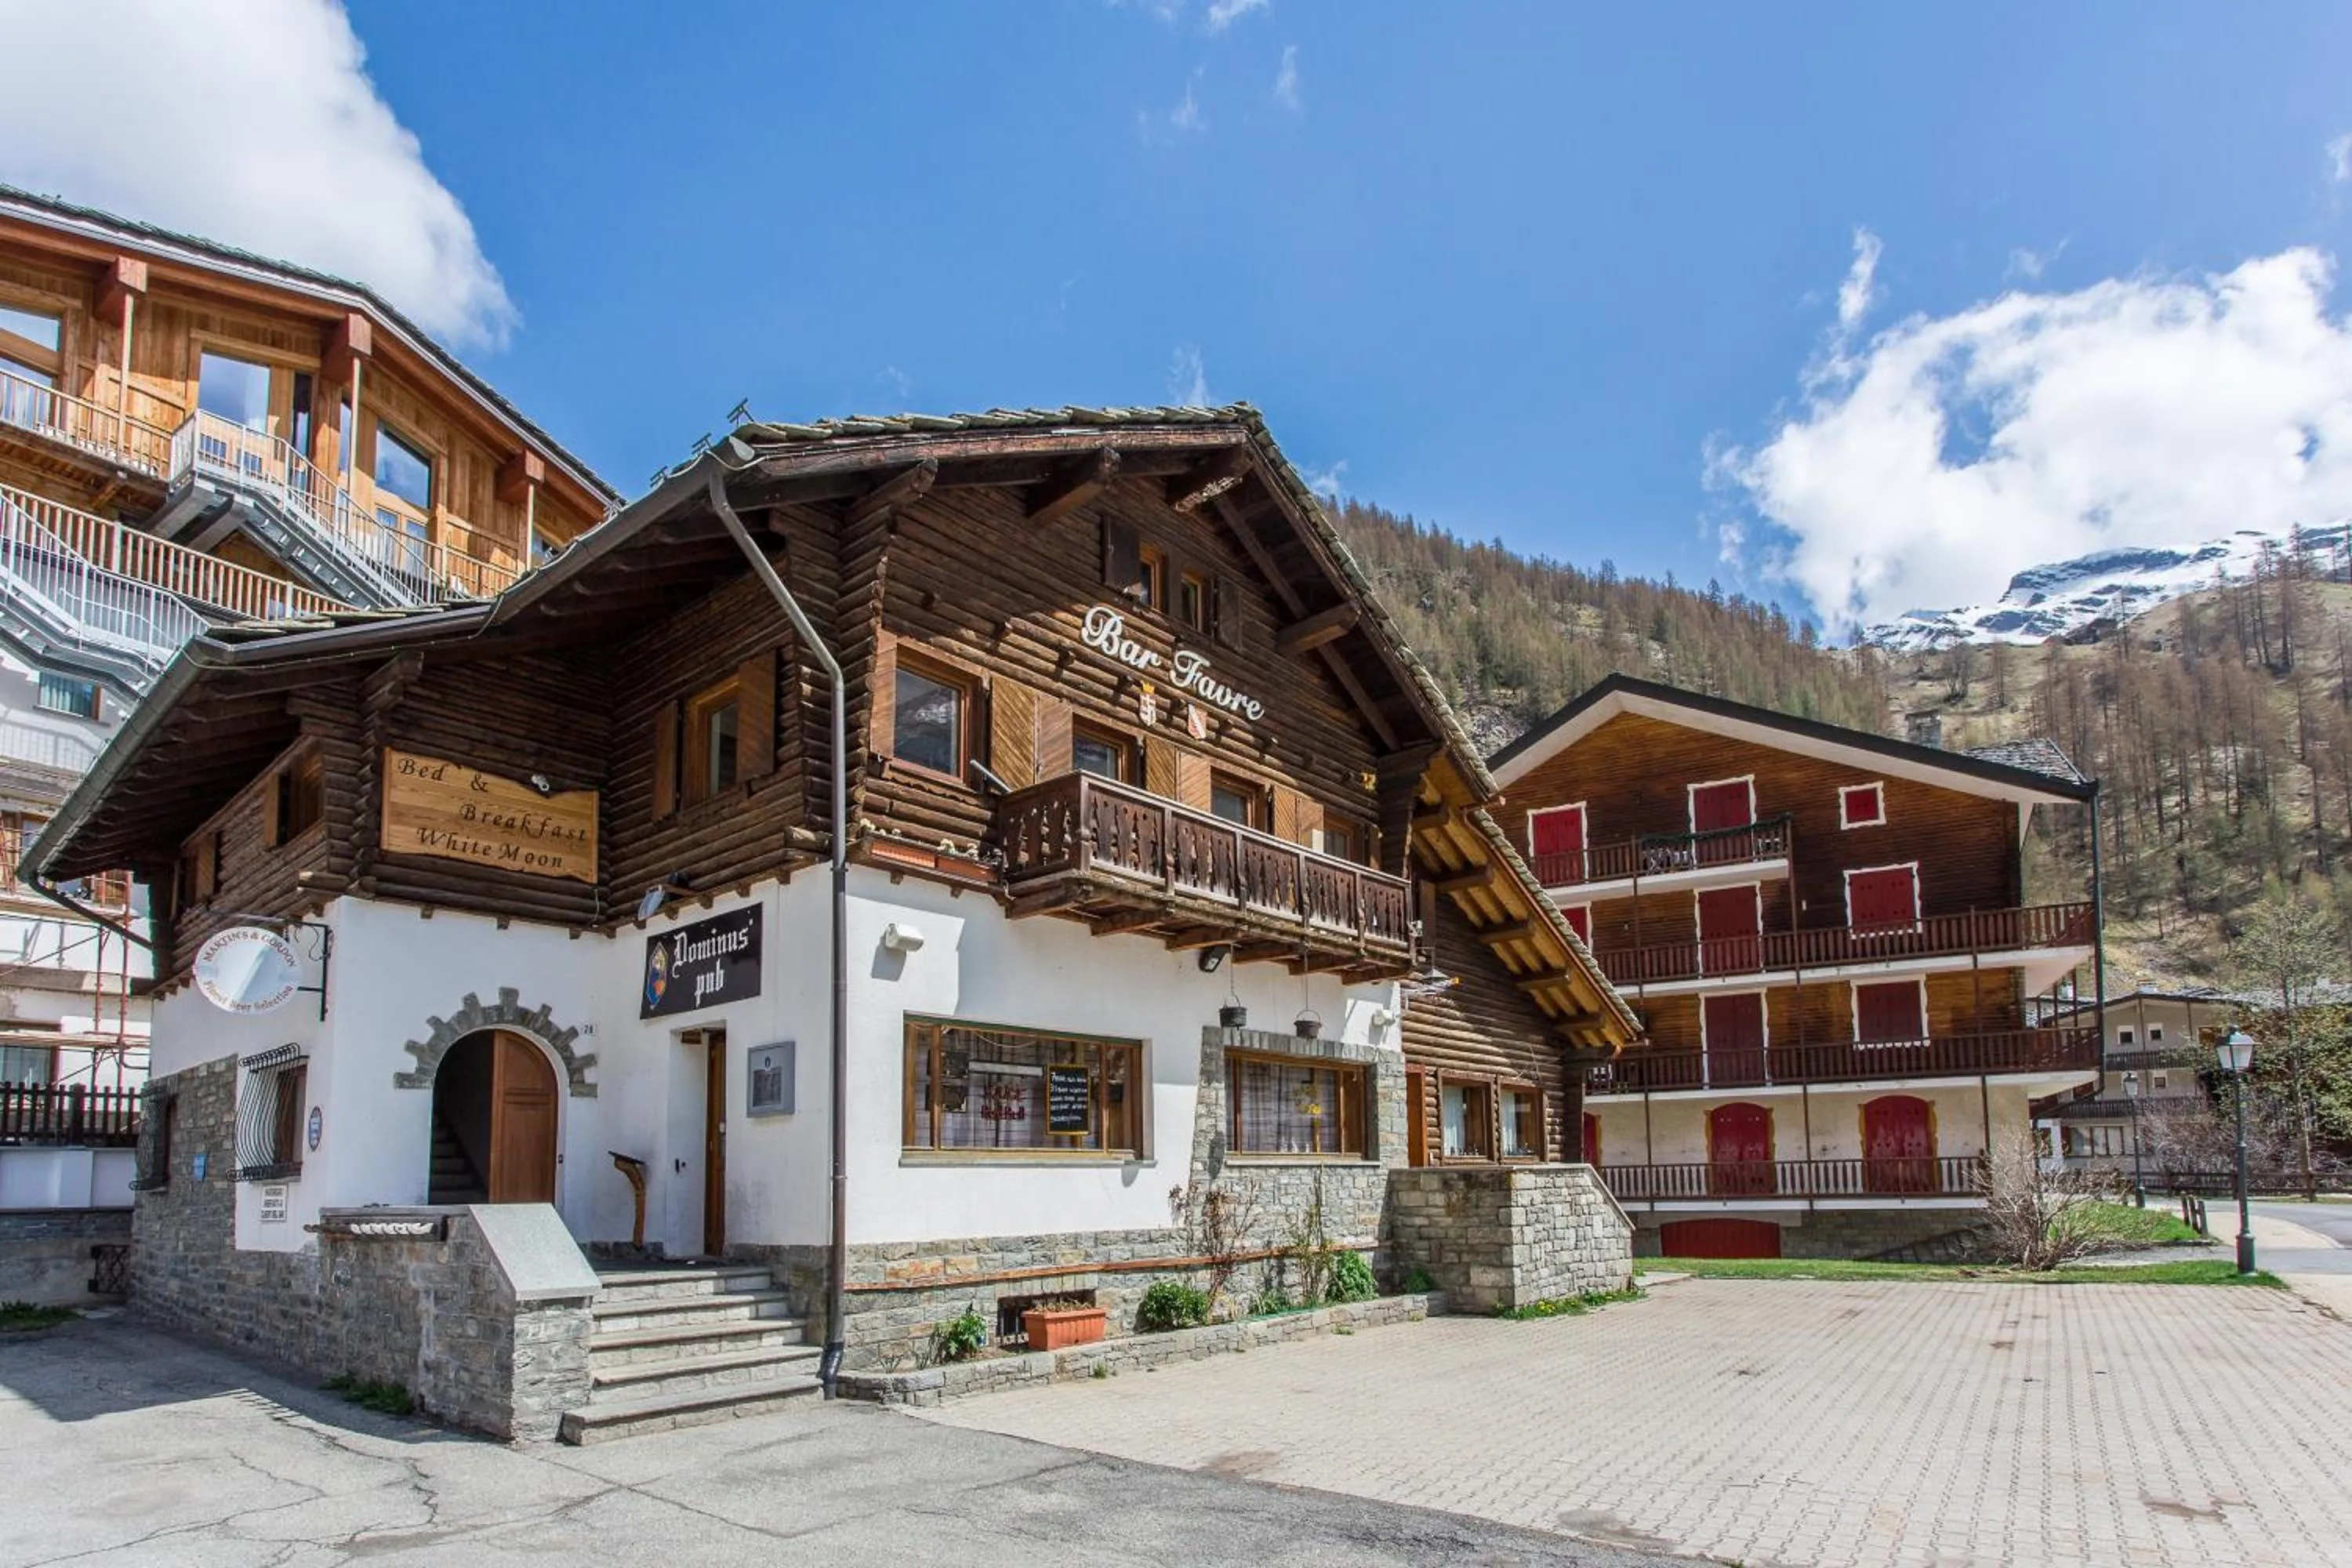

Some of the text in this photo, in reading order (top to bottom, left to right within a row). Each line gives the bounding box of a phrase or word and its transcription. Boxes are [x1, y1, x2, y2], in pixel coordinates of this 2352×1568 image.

[1081, 606, 1265, 720] Bar Favre
[397, 757, 488, 793] Bed &
[459, 804, 586, 841] Breakfast
[695, 958, 724, 1008] pub
